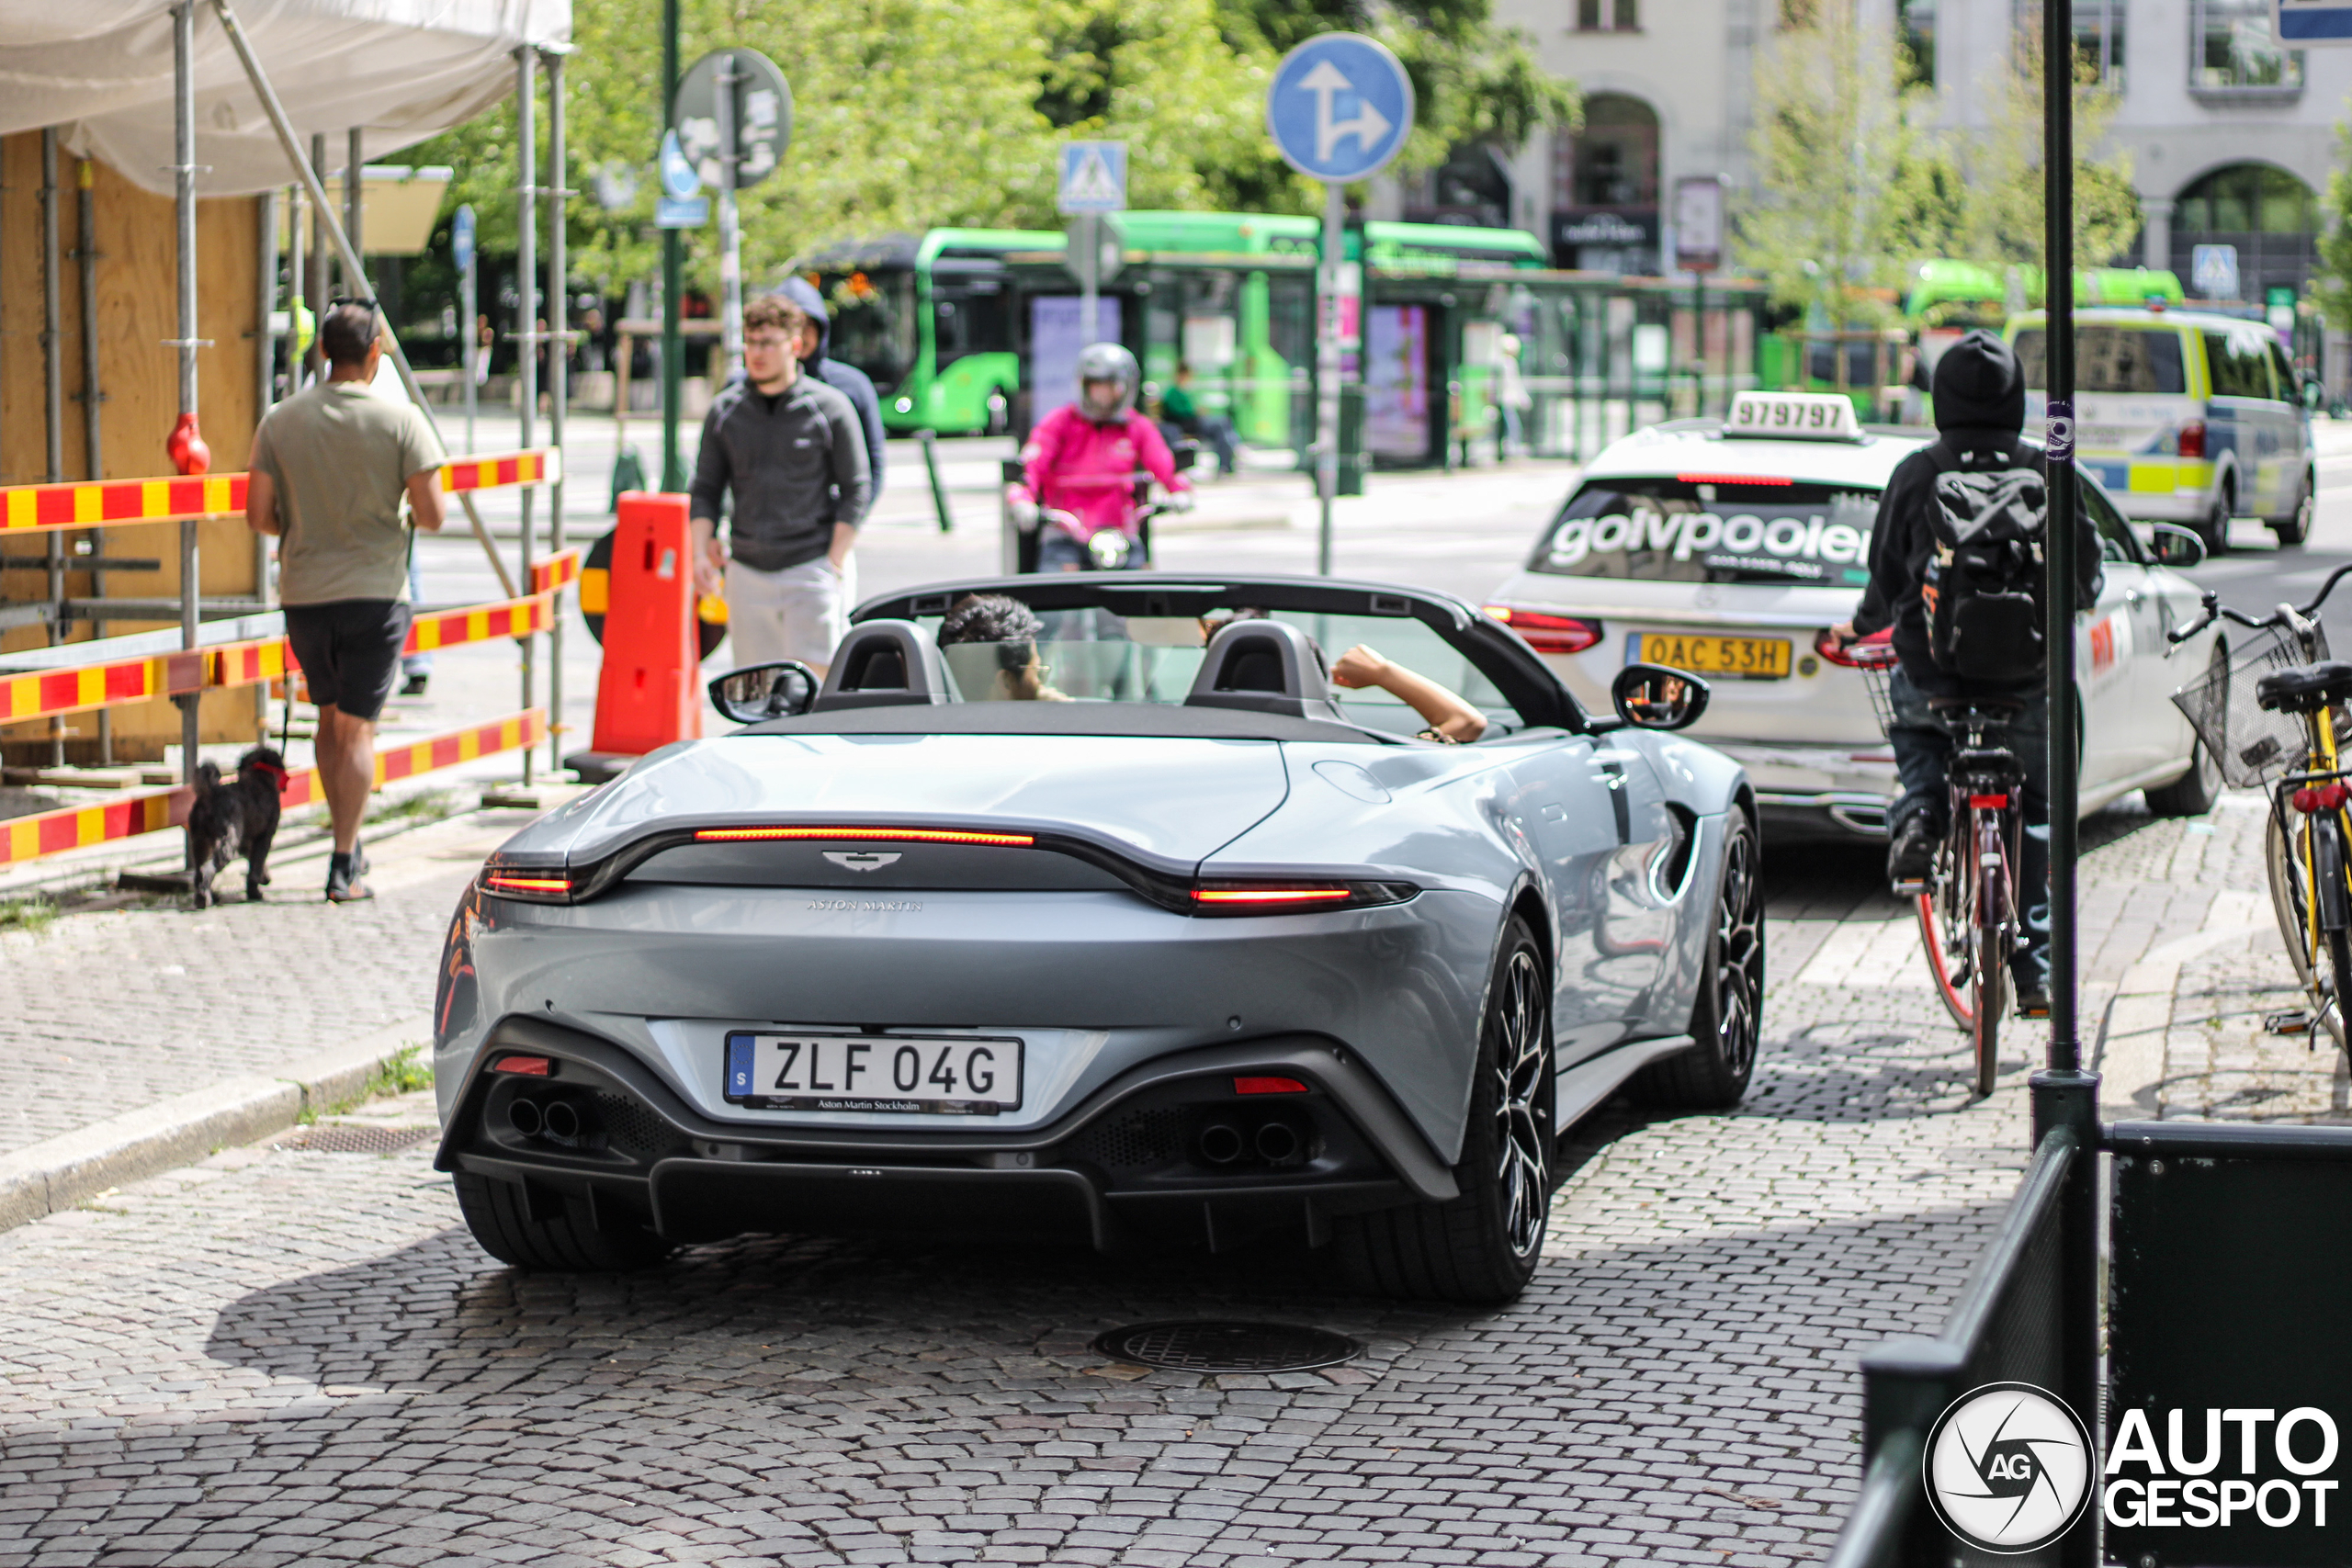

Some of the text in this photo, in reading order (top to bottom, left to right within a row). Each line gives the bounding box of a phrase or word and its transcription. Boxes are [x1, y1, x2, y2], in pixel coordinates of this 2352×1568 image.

[1739, 400, 1841, 428] 979797
[1650, 637, 1706, 666] OAC
[1720, 640, 1777, 669] 53H
[808, 899, 923, 912] ASTON MARTIN
[775, 1042, 994, 1094] ZLF 04G
[736, 1072, 746, 1086] S
[818, 1100, 920, 1111] Aston Martin Stockholm
